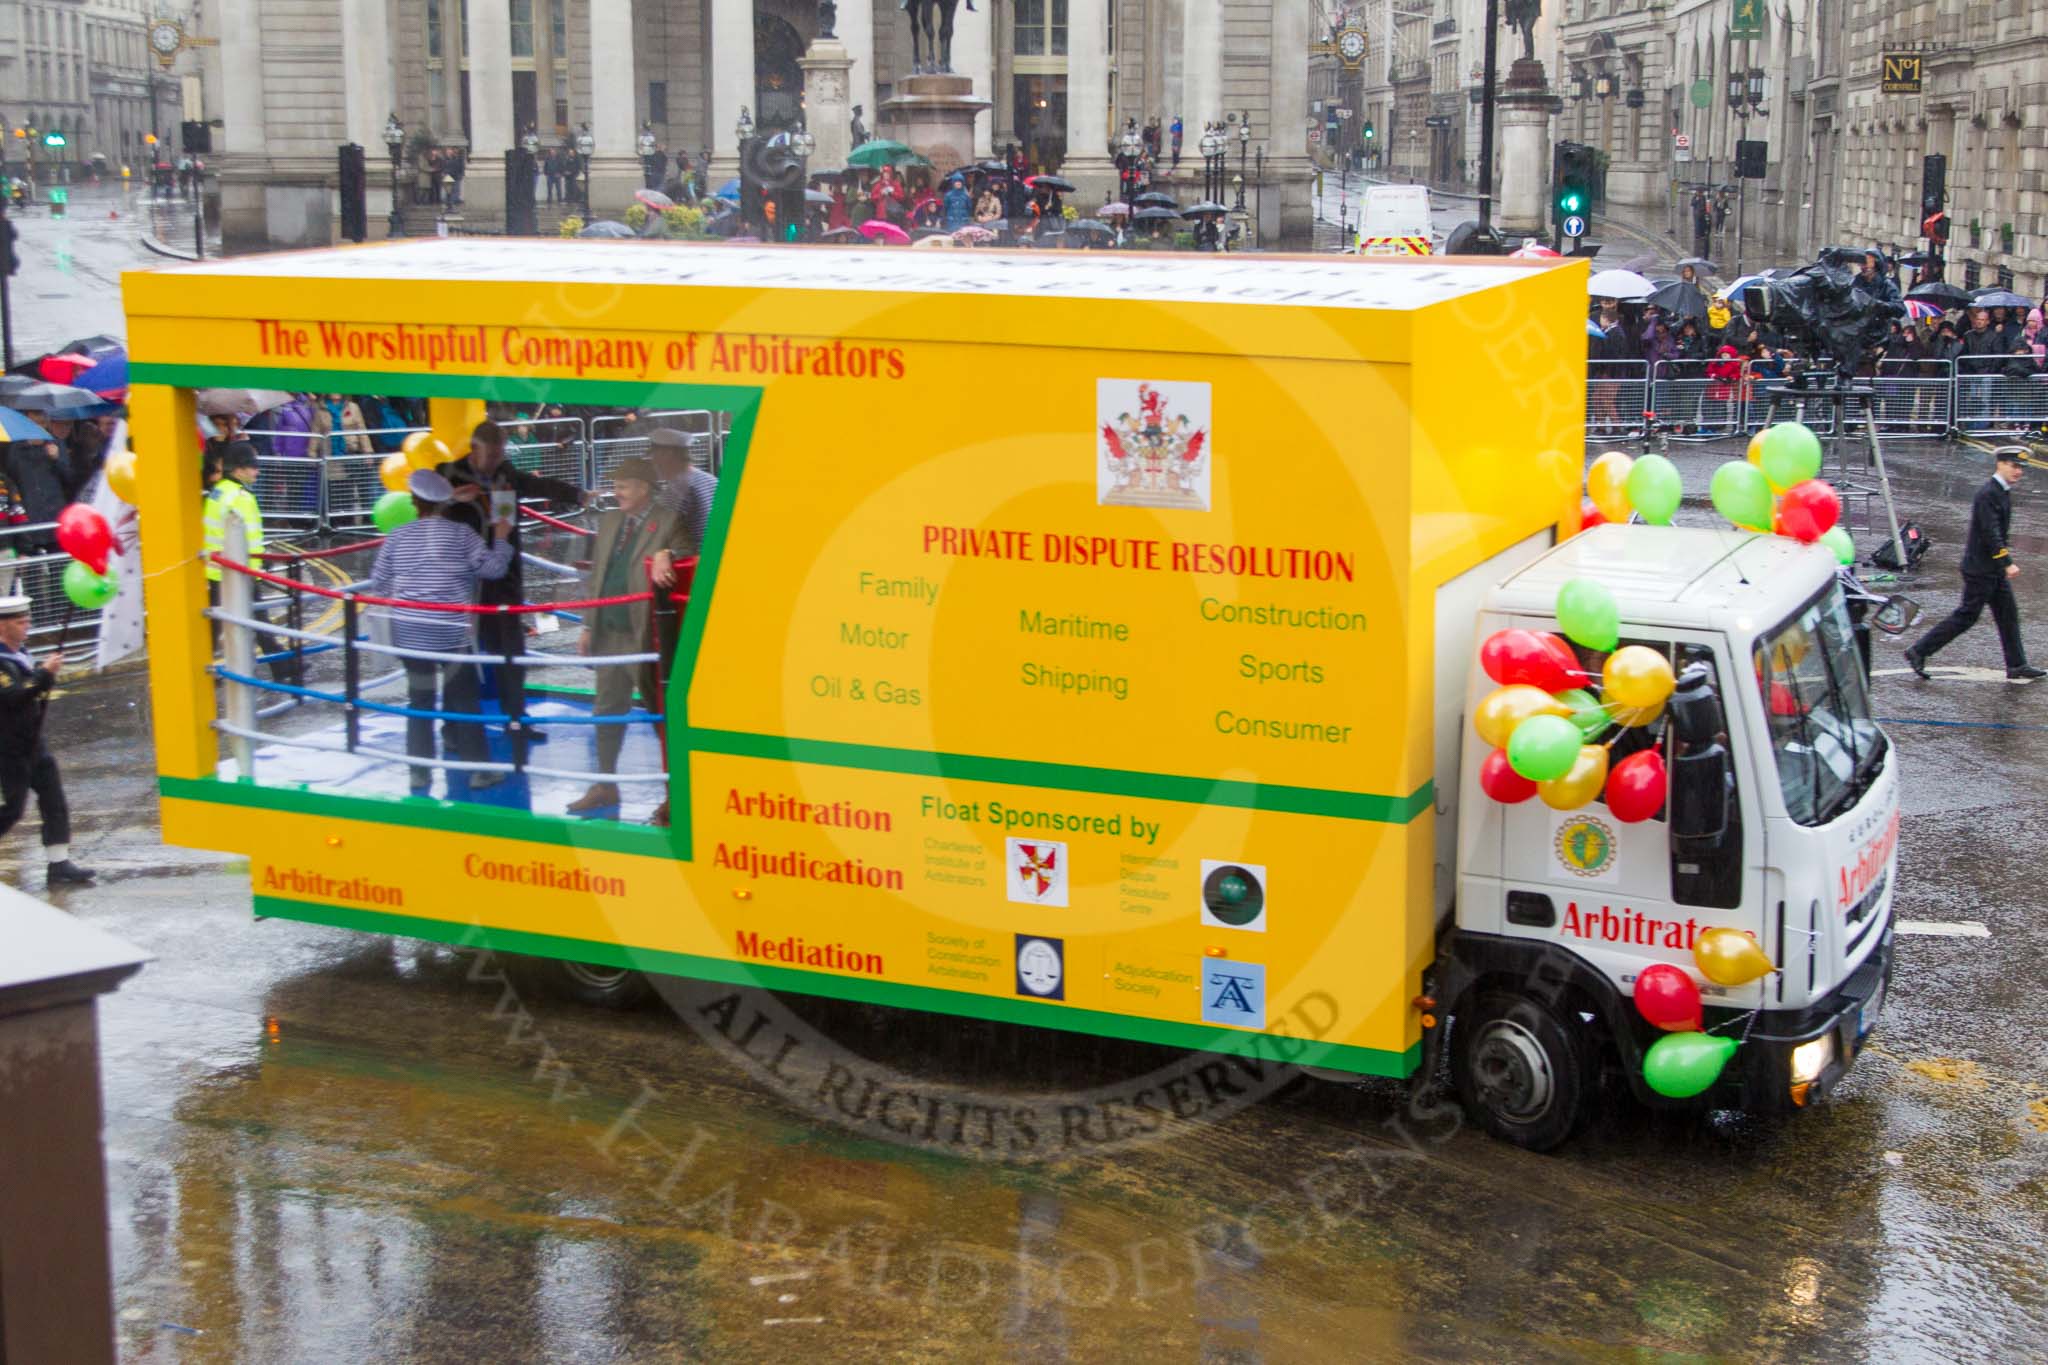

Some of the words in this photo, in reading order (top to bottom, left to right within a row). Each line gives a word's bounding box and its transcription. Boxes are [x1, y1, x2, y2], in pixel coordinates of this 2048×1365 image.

[257, 319, 311, 357] The
[318, 321, 487, 370] Worshipful
[501, 326, 649, 378] Company
[665, 332, 698, 370] of
[711, 335, 905, 380] Arbitrators
[924, 526, 1032, 560] PRIVATE
[1043, 533, 1160, 570] DISPUTE
[1171, 542, 1354, 583] RESOLUTION
[858, 570, 939, 608] Family
[1019, 609, 1130, 642] Maritime
[1200, 597, 1367, 631] Construction
[840, 623, 910, 649] Motor
[1022, 662, 1128, 701] Shipping
[1240, 653, 1324, 684] Sports
[810, 674, 842, 698] Oil
[849, 677, 866, 702] &
[874, 681, 921, 707] Gas
[1215, 710, 1352, 743] Consumer
[726, 788, 891, 832] Arbitration
[921, 795, 980, 823] Float
[988, 801, 1122, 837] Sponsored
[1130, 816, 1160, 846] by
[266, 866, 403, 905] Arbitration
[464, 854, 624, 896] Conciliation
[715, 842, 903, 890] Adjudication
[736, 930, 883, 976] Mediation
